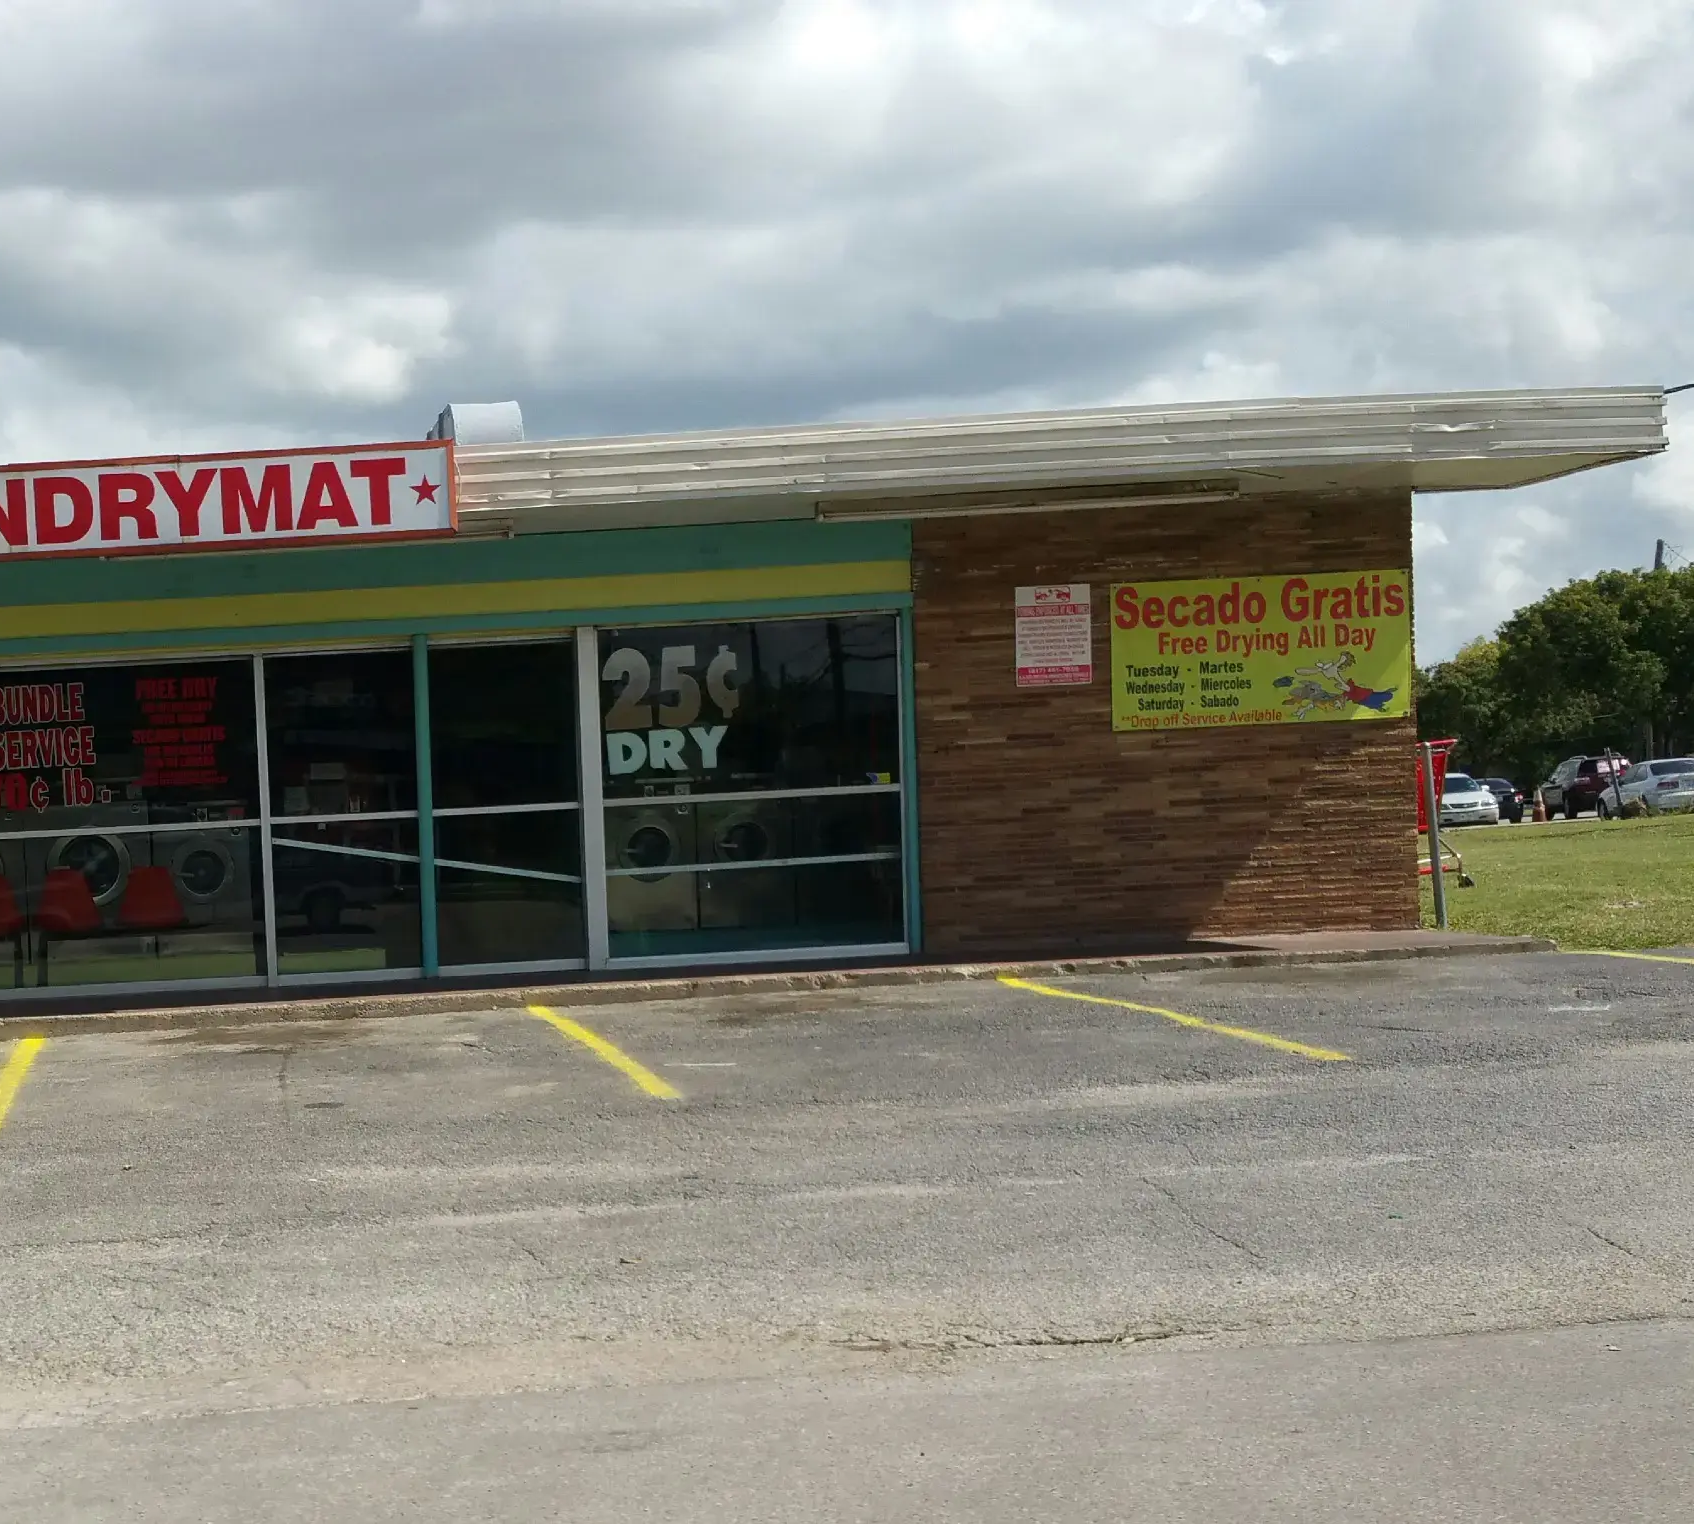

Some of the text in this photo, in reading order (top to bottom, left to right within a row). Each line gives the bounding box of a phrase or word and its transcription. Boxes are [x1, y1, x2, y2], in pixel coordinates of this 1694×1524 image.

[1115, 575, 1405, 630] Secado Gratis
[1158, 623, 1377, 658] Free Drying All Day
[1126, 664, 1180, 679] Tuesday
[1199, 661, 1244, 674] Martes
[602, 645, 740, 731] 25¢
[1126, 681, 1185, 695] Wednesday
[1200, 677, 1252, 691] Miercoles
[1137, 698, 1185, 712] Saturday
[1200, 694, 1240, 709] Sabado
[1163, 712, 1179, 726] off
[1182, 711, 1227, 725] Service
[1228, 709, 1282, 724] Available
[606, 725, 728, 776] DRY
